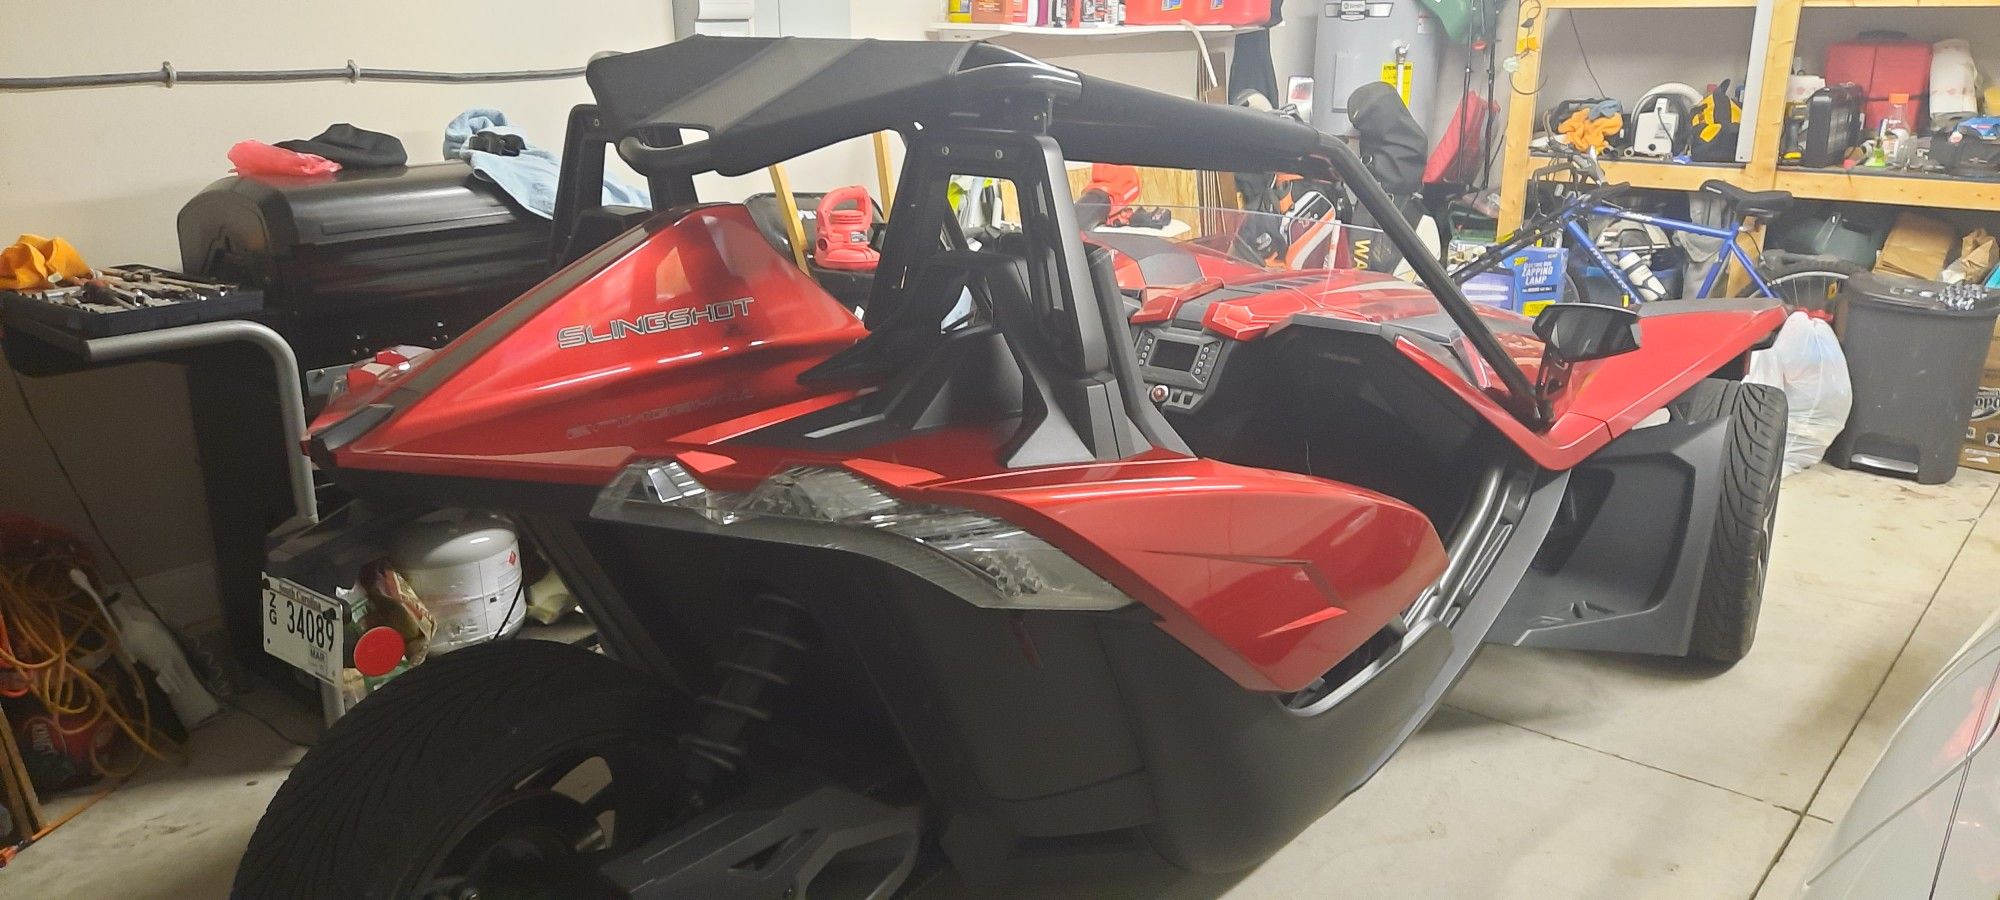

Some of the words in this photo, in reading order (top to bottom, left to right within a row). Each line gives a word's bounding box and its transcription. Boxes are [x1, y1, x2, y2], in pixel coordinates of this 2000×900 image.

[1522, 265, 1553, 277] ZAPPING
[1525, 276, 1547, 285] LAMP
[558, 297, 754, 348] SLINGSHOT
[286, 600, 334, 653] 34089
